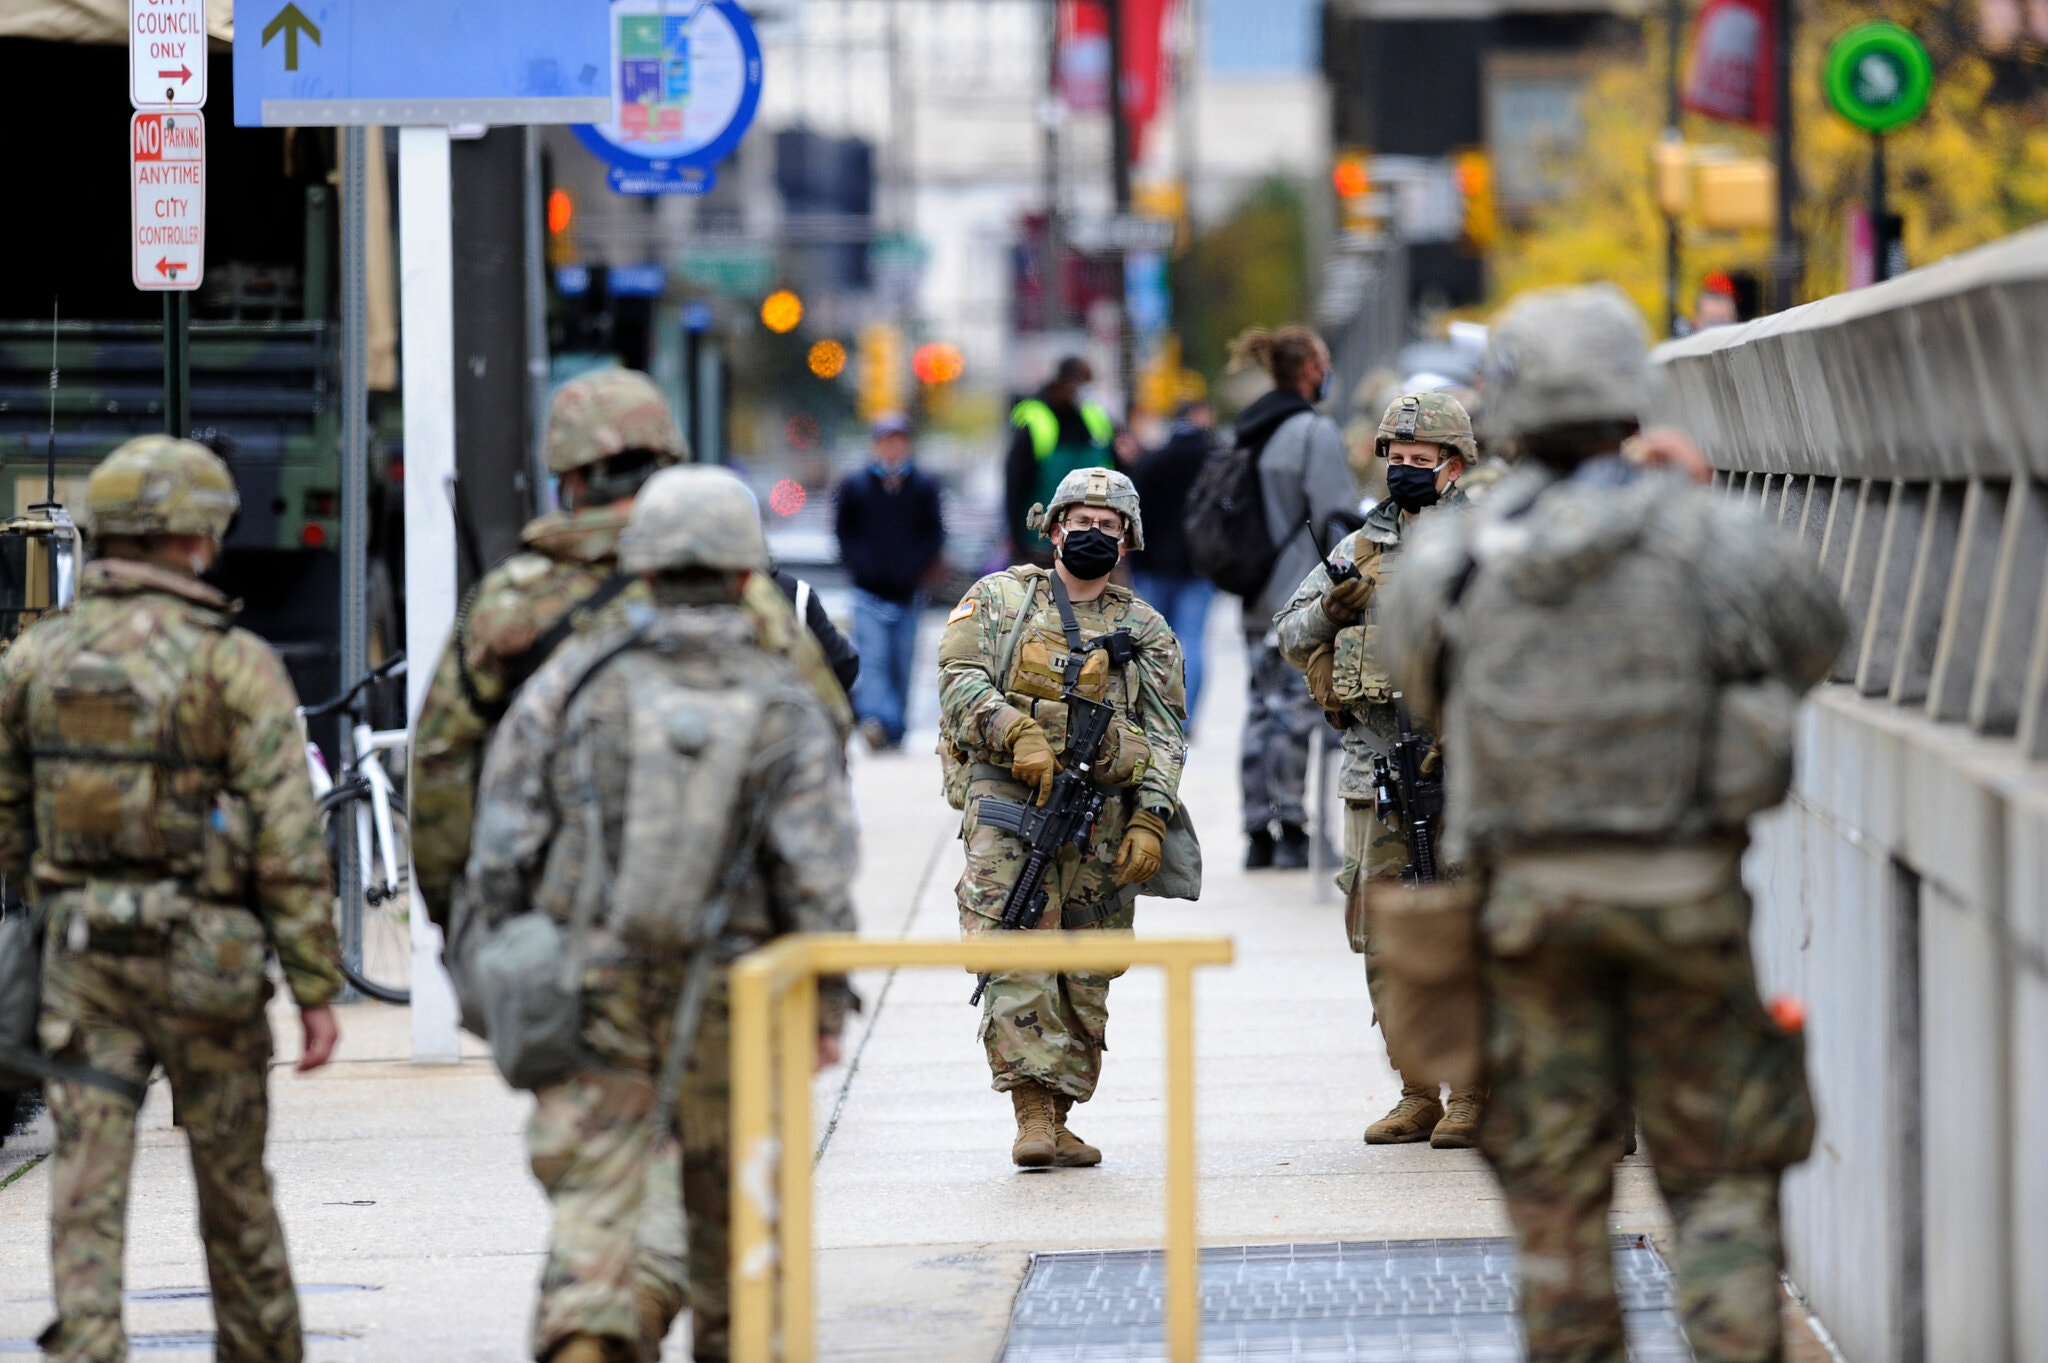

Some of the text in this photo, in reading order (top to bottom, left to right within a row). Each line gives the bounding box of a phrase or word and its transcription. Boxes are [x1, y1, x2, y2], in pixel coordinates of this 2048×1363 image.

[137, 12, 200, 34] COUNCIL
[150, 42, 186, 59] ONLY
[136, 121, 199, 154] NO PARKING
[139, 166, 200, 185] ANYTIME
[154, 199, 188, 218] CITY
[139, 226, 199, 246] CONTROLLER
